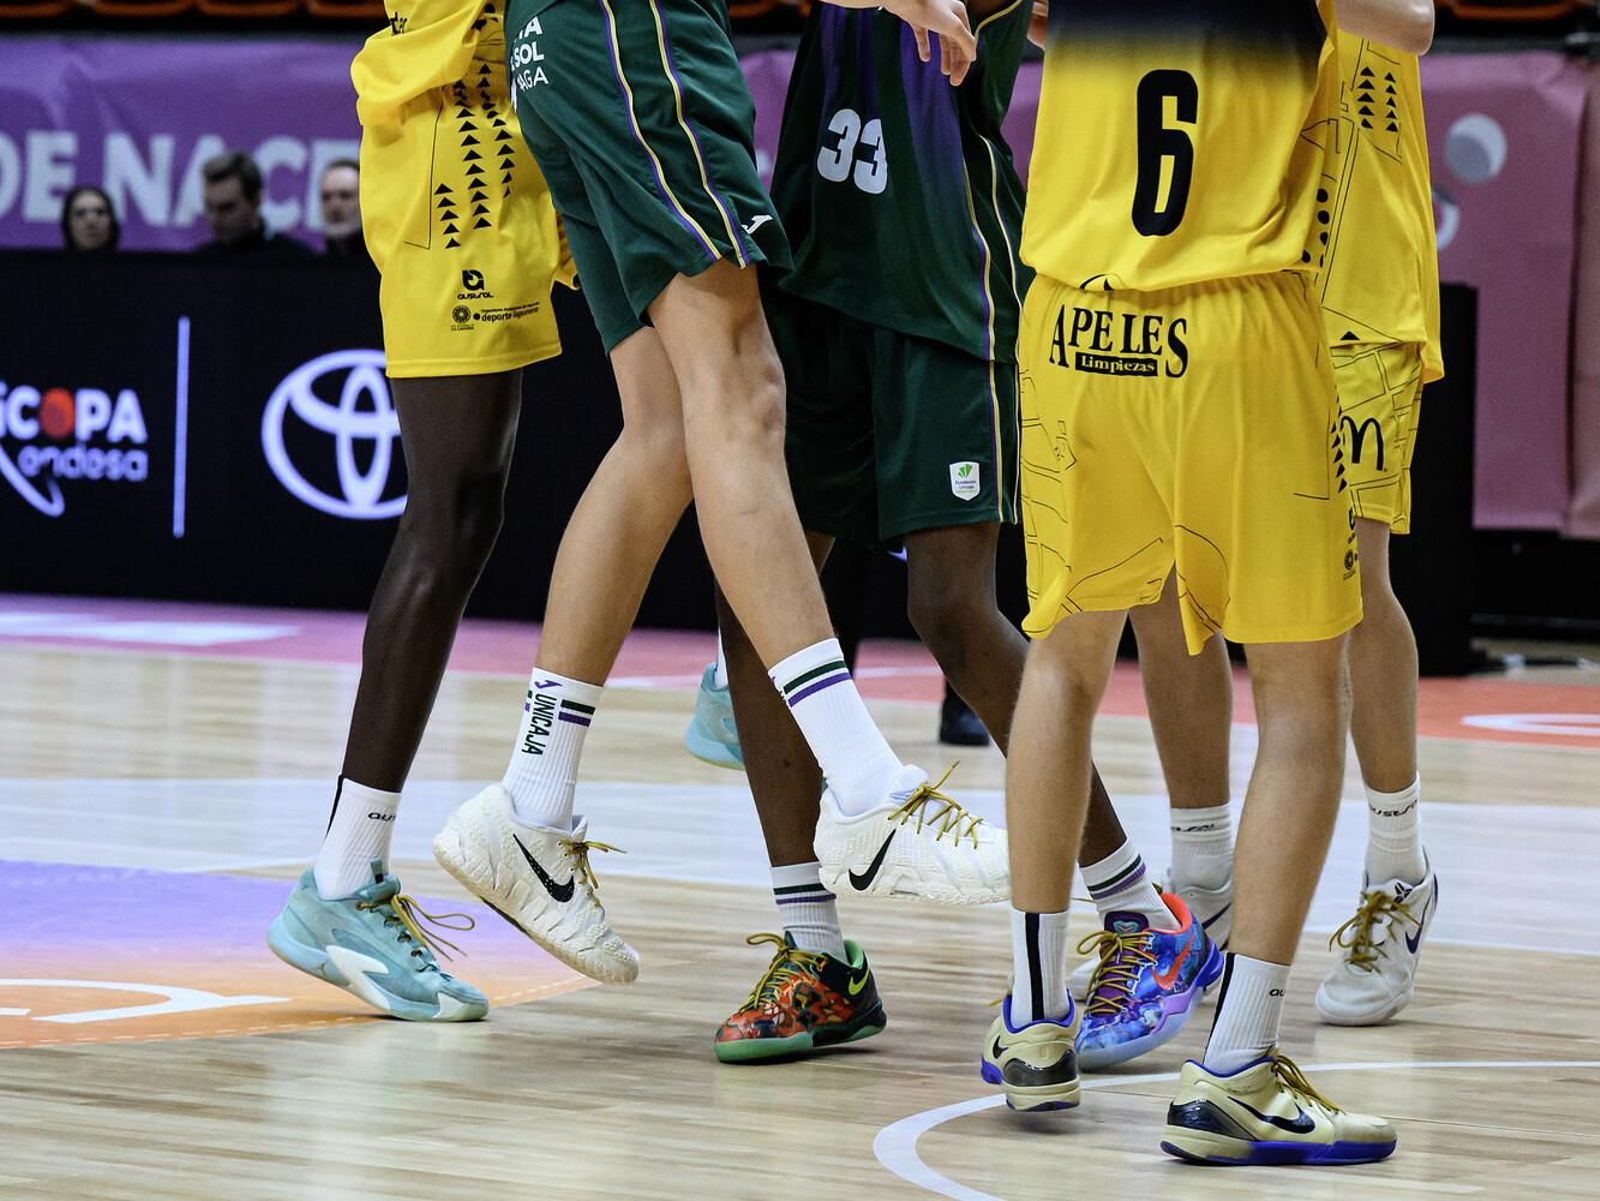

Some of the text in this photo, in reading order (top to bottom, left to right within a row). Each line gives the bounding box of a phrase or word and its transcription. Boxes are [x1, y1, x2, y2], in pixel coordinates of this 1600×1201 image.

[816, 108, 888, 195] 33
[1132, 69, 1199, 237] 6
[521, 693, 558, 756] UNICAJA
